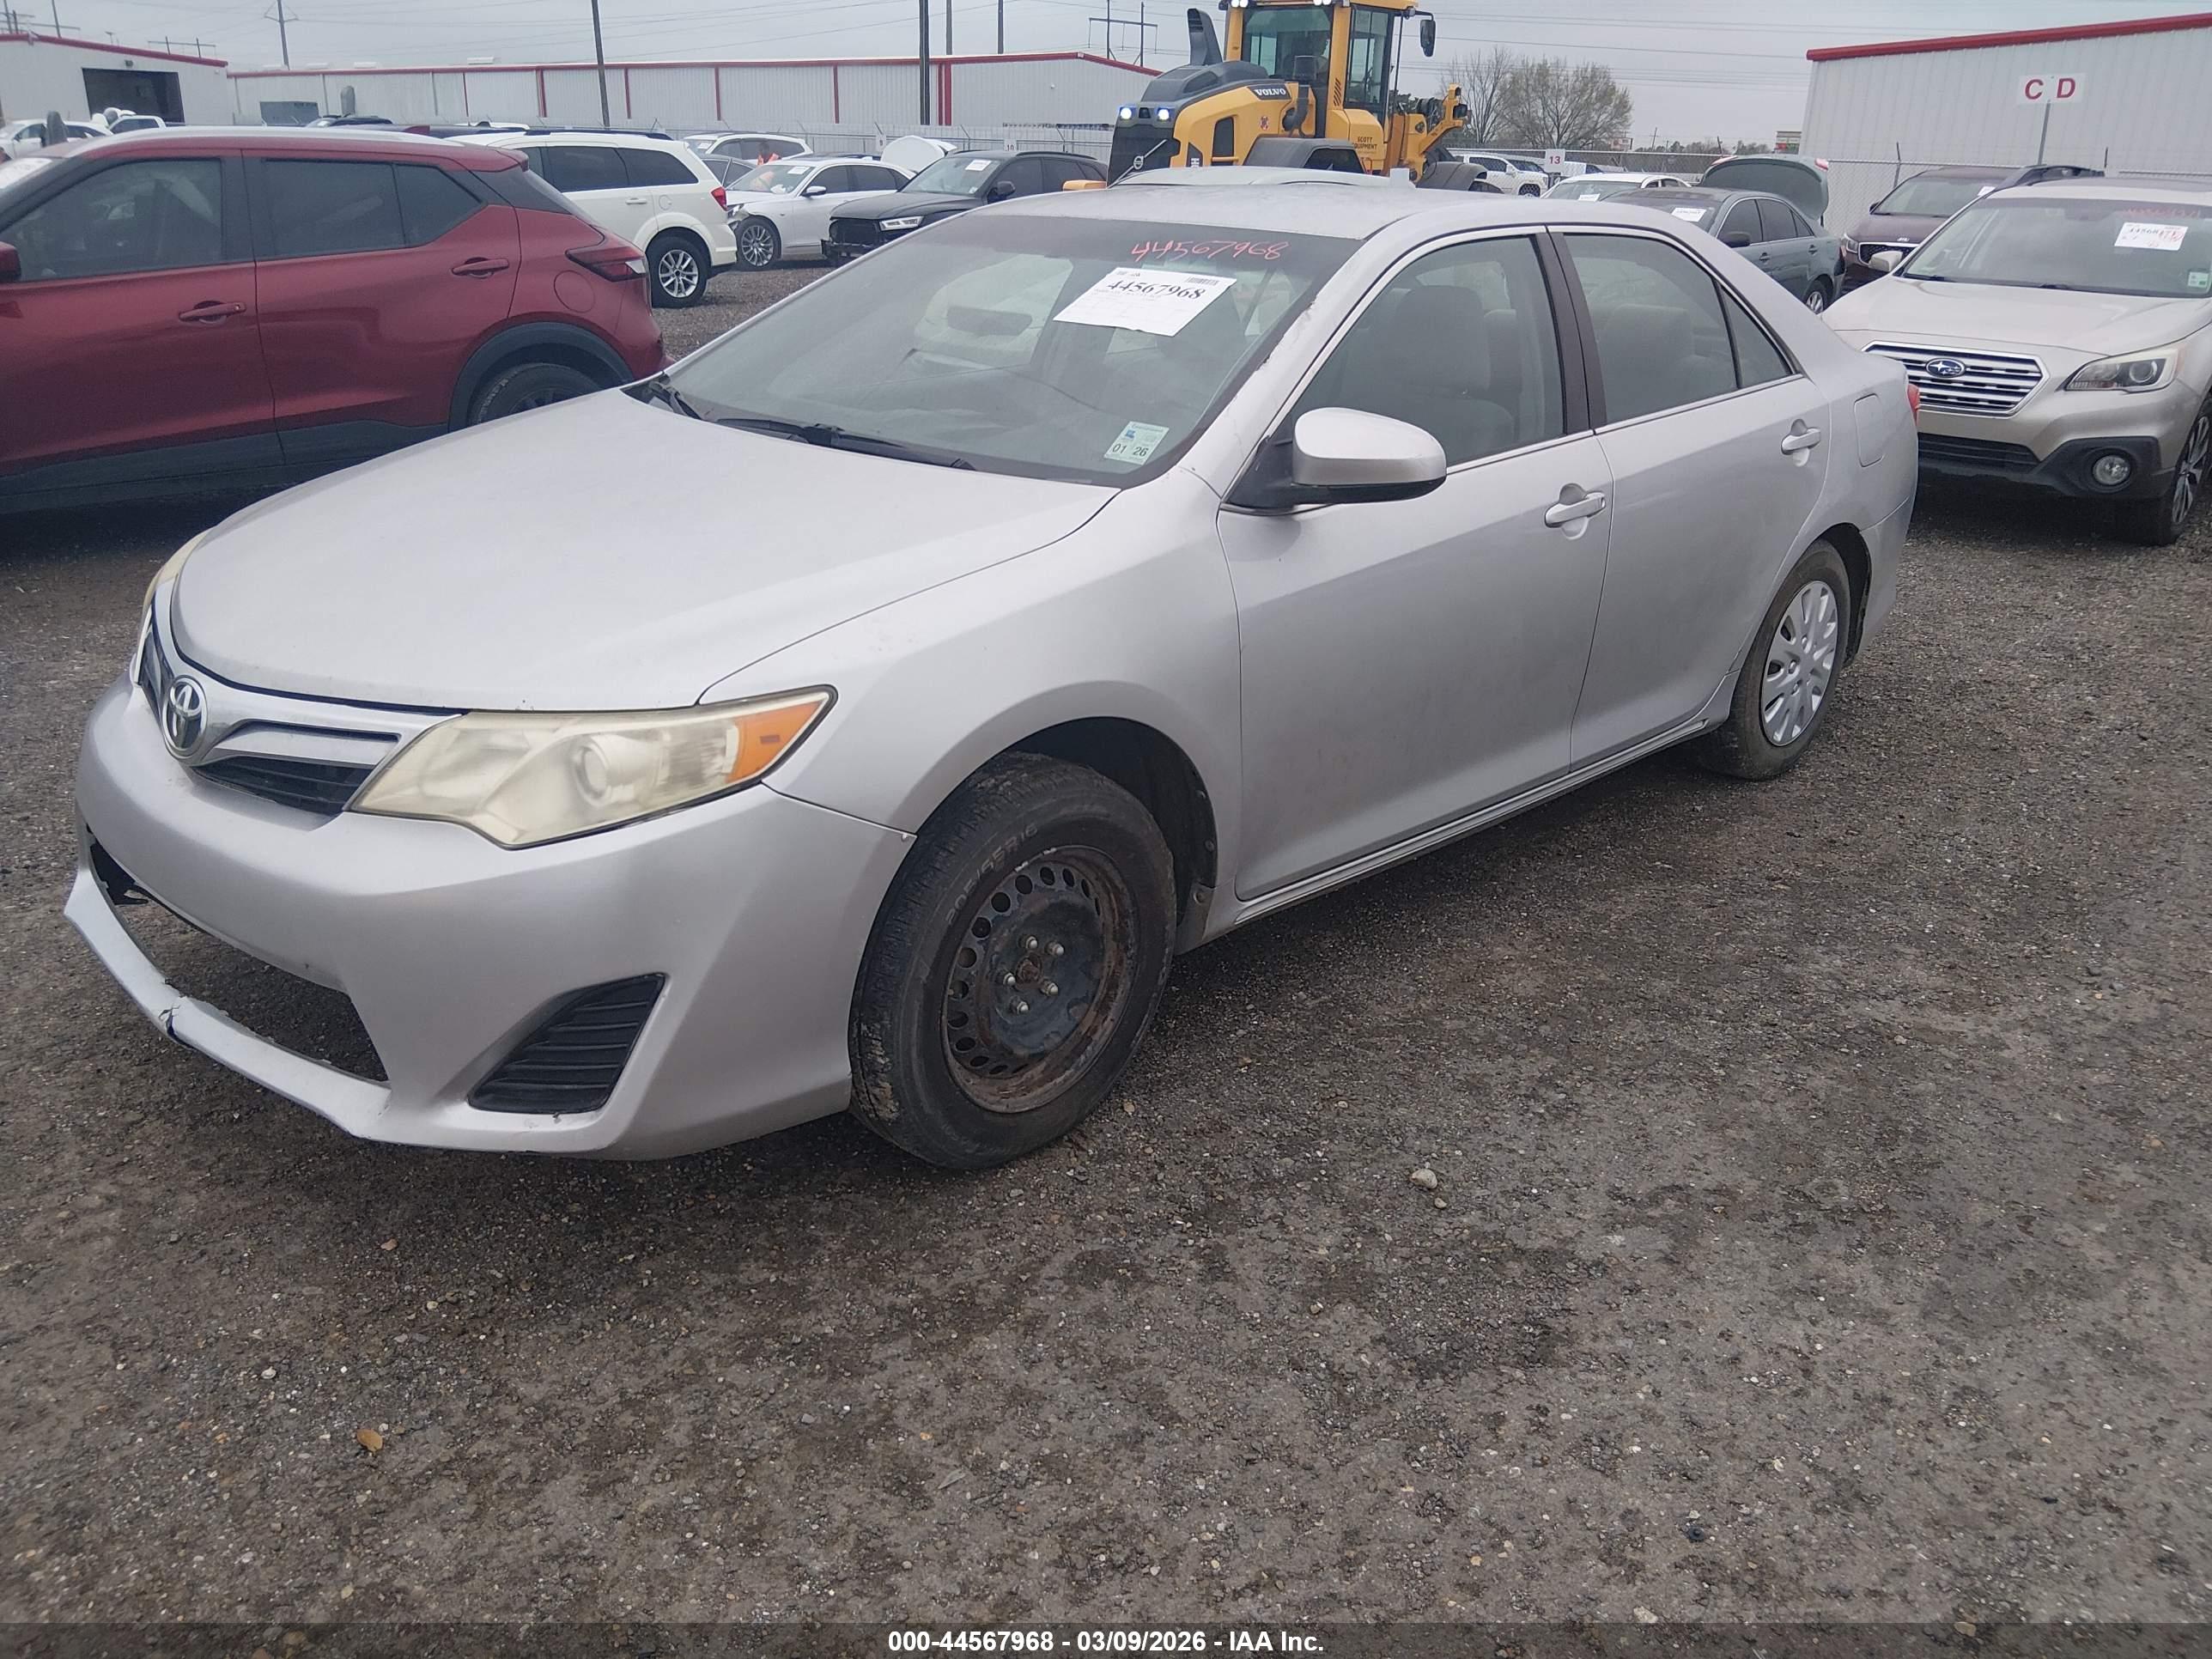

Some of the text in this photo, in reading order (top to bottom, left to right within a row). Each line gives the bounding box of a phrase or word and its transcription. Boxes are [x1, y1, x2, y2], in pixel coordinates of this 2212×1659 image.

[1254, 88, 1286, 96] VOLVO
[2025, 77, 2076, 100] C D
[1549, 155, 1561, 164] 13
[1131, 240, 1289, 262] 44567968
[1107, 280, 1206, 300] 44567968
[1113, 443, 1149, 457] 01 26
